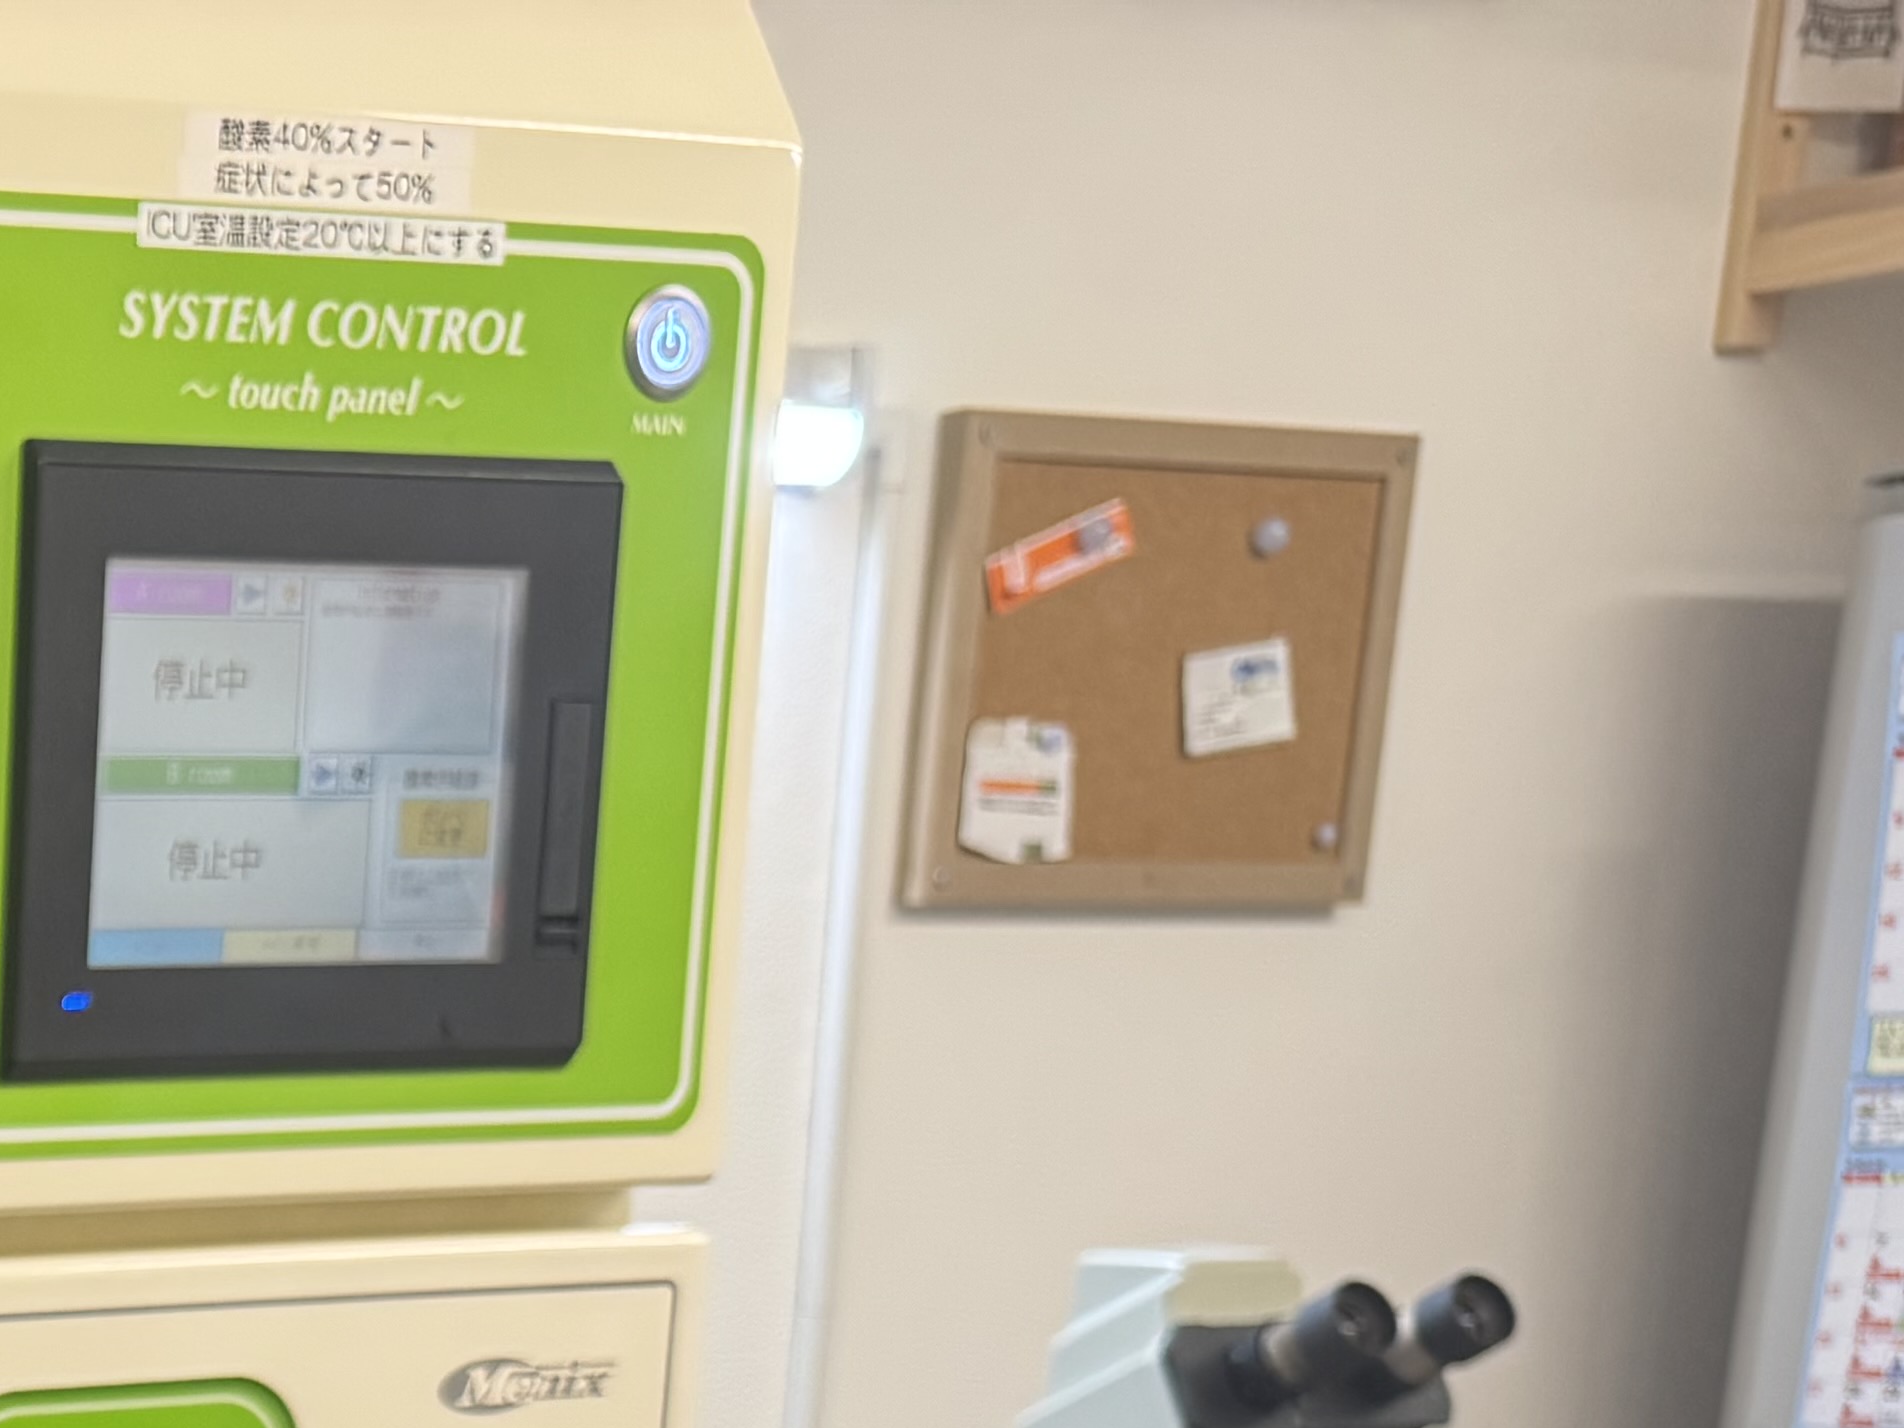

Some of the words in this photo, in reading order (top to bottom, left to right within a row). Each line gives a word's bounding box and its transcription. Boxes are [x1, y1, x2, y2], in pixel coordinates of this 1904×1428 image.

[218, 118, 436, 160] 酸素40%スタート
[214, 162, 434, 204] 症状によって50%
[119, 289, 294, 347] SYSTEM
[307, 299, 529, 357] CONTROL
[228, 371, 320, 413] touch
[327, 377, 423, 423] panel
[630, 412, 686, 437] MAIN
[153, 658, 248, 702] 停止中
[168, 838, 262, 882] 停止中
